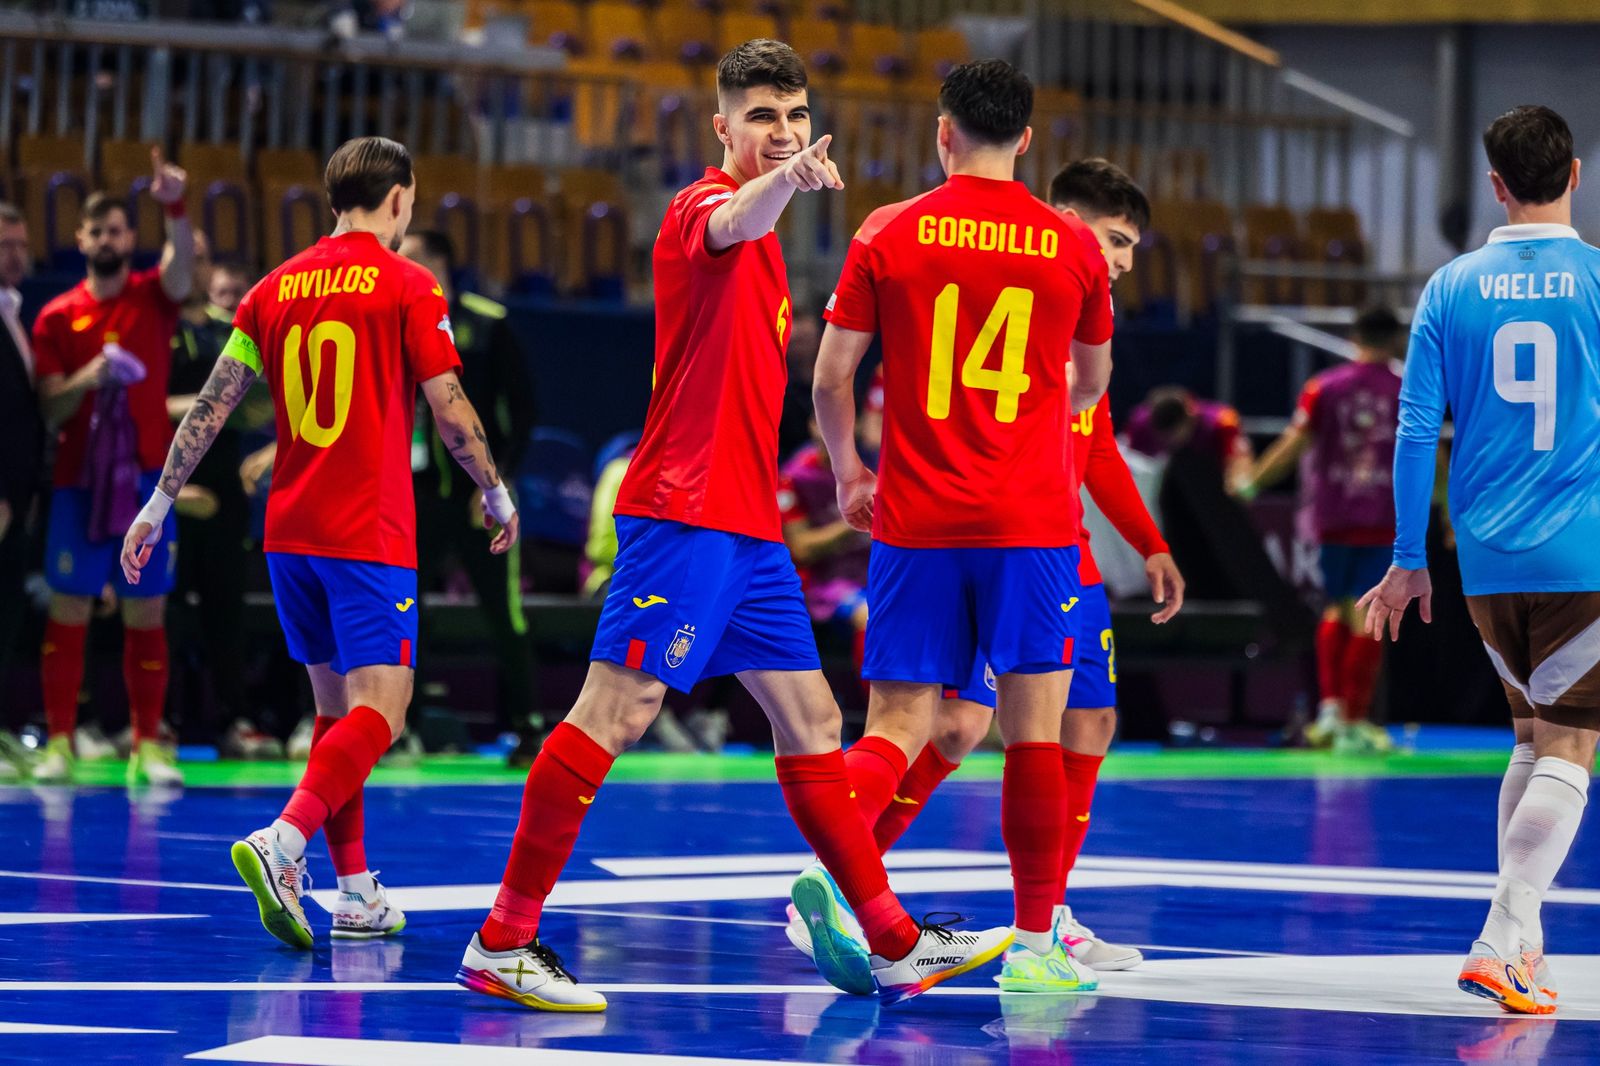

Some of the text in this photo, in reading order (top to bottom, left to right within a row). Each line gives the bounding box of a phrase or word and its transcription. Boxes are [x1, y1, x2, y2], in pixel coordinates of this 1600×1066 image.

[917, 215, 1059, 259] GORDILLO
[277, 264, 380, 302] RIVILLOS
[1479, 271, 1575, 300] VAELEN
[926, 282, 1035, 424] 14
[283, 320, 357, 449] 10
[1493, 320, 1558, 451] 9
[915, 956, 965, 967] MUNIC
